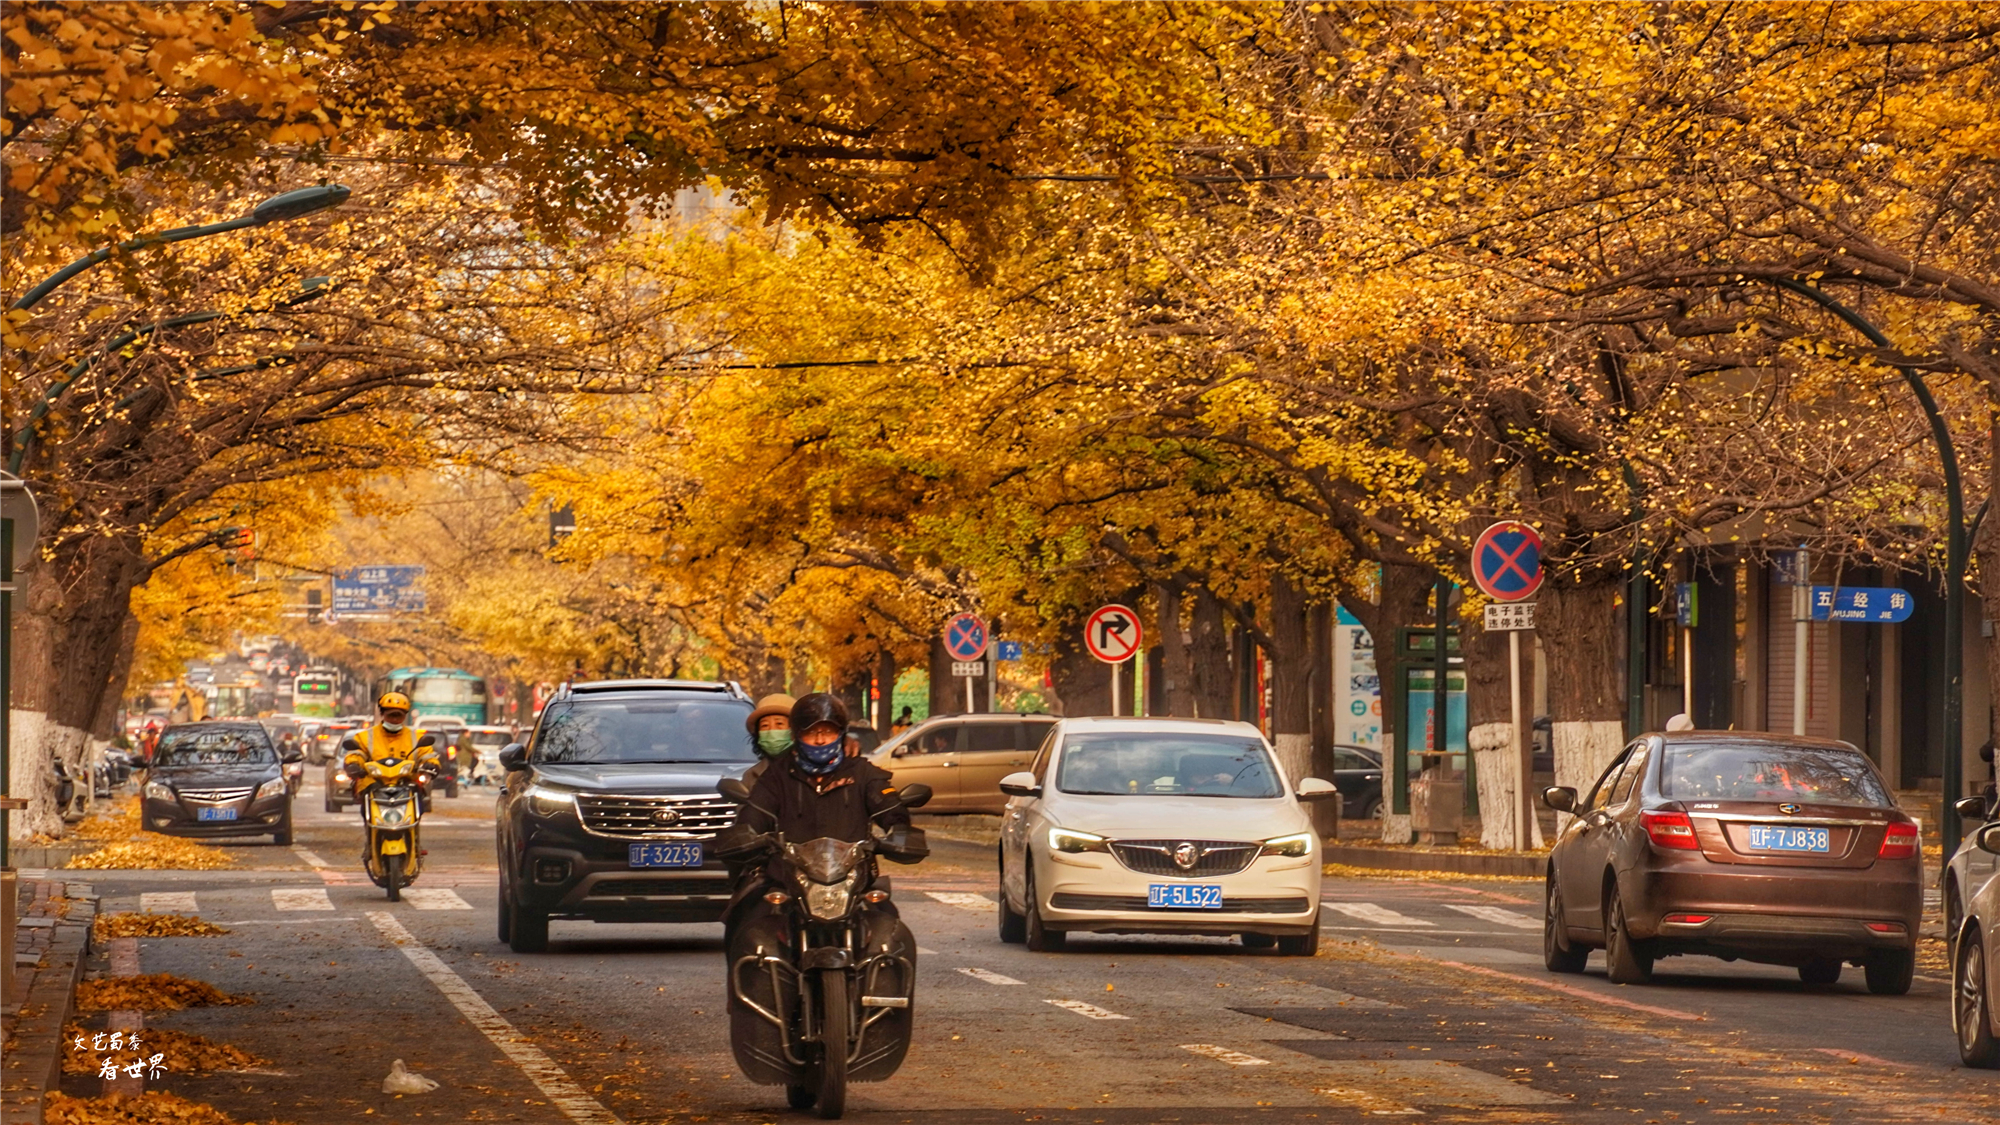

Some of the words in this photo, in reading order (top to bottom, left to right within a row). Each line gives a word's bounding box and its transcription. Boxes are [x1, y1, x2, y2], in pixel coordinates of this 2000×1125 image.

[1816, 591, 1906, 609] 五经街
[1831, 609, 1866, 618] WUJING
[1879, 611, 1893, 619] JIE
